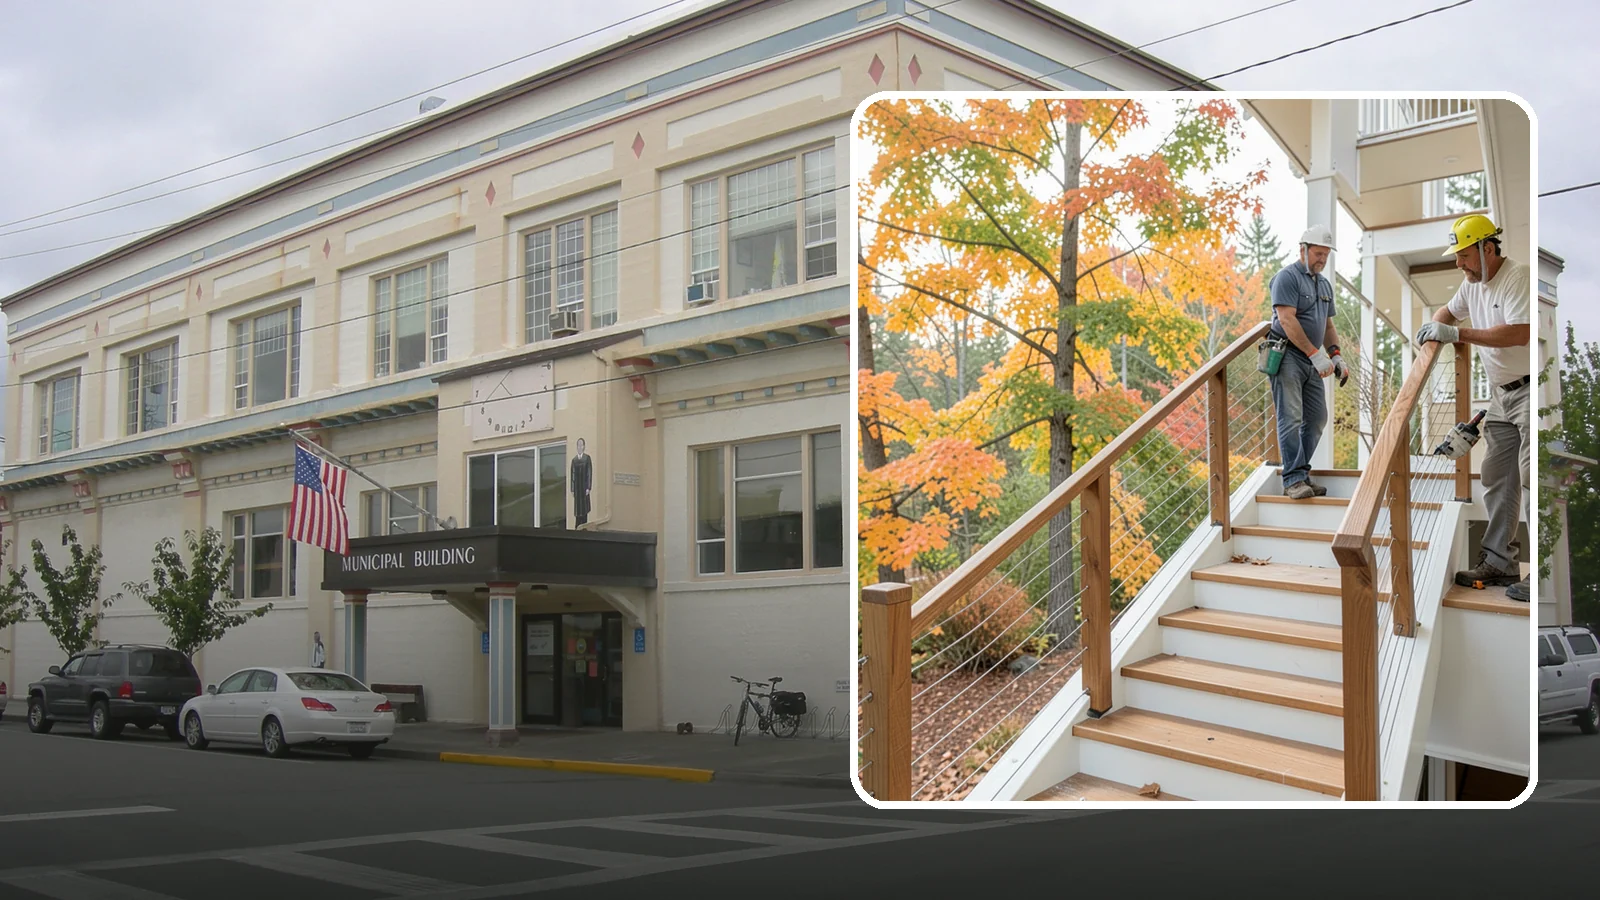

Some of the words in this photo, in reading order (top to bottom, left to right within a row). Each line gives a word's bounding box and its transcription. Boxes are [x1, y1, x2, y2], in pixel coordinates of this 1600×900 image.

[536, 402, 540, 410] 4
[481, 406, 485, 415] 8
[488, 417, 492, 426] 9
[529, 414, 533, 422] 3
[521, 420, 525, 428] 2
[342, 552, 405, 572] MUNICIPAL
[414, 546, 475, 567] BUILDING
